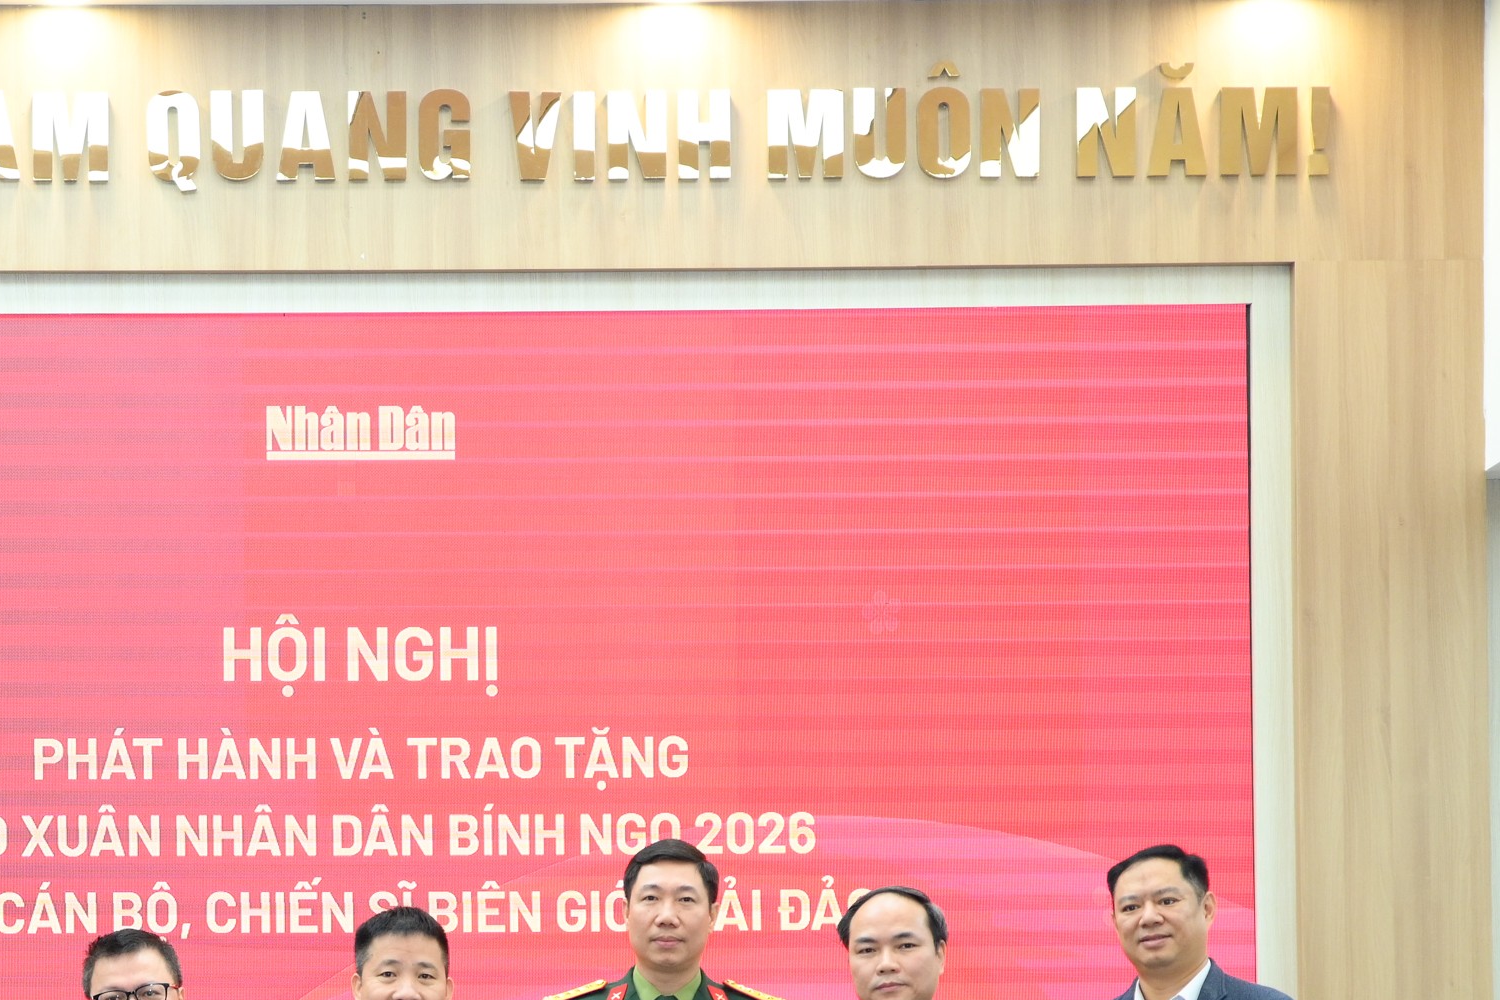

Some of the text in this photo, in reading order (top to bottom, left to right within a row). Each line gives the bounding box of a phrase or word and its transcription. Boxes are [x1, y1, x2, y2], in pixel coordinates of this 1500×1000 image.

[146, 88, 471, 192] QUANG
[508, 89, 731, 181] VINH
[766, 61, 1041, 179] MUÔN
[1075, 62, 1331, 177] NĂM!
[265, 405, 456, 450] Nhân Dân
[222, 613, 499, 697] HỘI NGHỊ
[33, 726, 690, 790] PHÁT HÀNH VÀ TRAO TẶNG
[21, 804, 161, 857] XUÂN
[176, 804, 318, 857] NHÂN
[332, 804, 434, 857] DÂN
[448, 804, 565, 856] BÍNH
[694, 811, 817, 855] 2026
[206, 876, 356, 934] CHIẾN
[428, 884, 541, 933] BIÊN
[556, 880, 628, 933] GI
[712, 876, 762, 932] ẢI
[777, 875, 871, 931] ĐẢ
